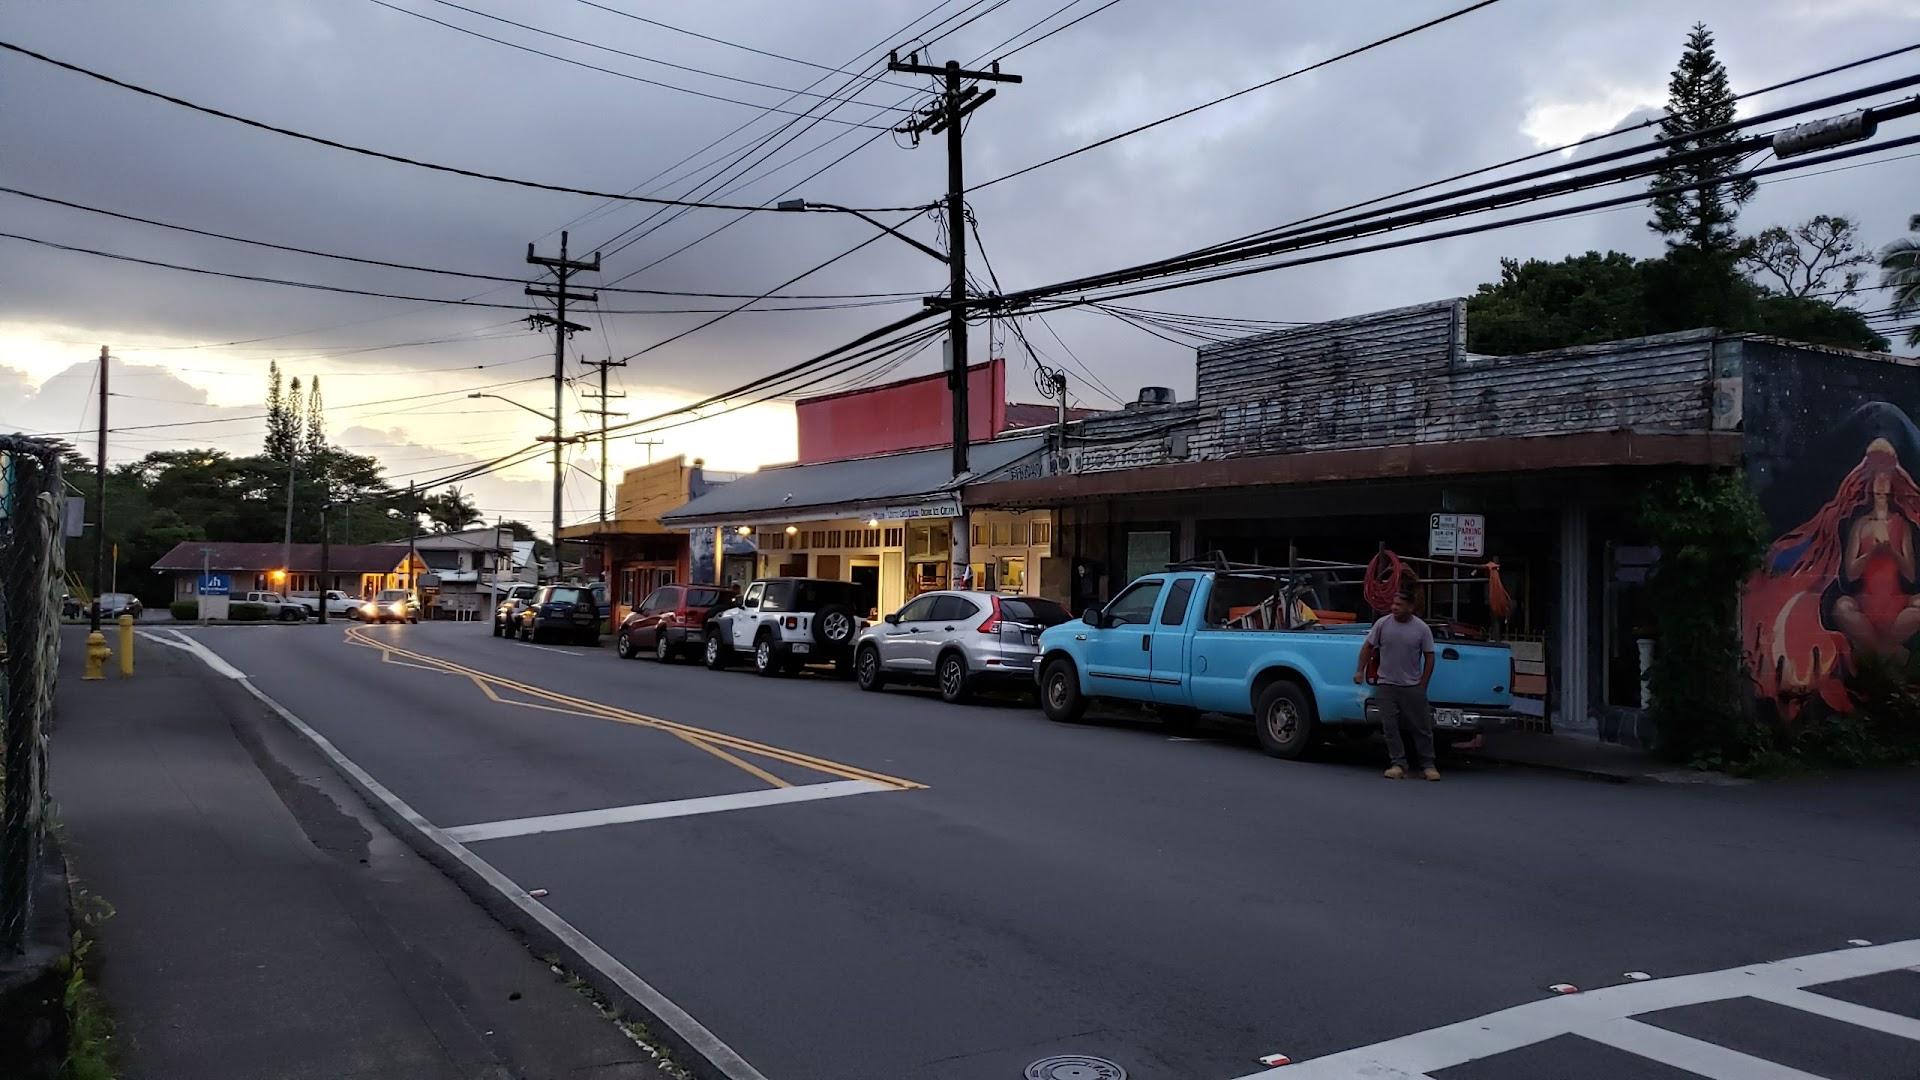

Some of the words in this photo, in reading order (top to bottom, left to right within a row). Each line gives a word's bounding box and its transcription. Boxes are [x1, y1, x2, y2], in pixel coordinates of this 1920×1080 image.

[1432, 516, 1439, 528] 2
[1464, 519, 1475, 527] NO
[1458, 527, 1482, 536] PARKING
